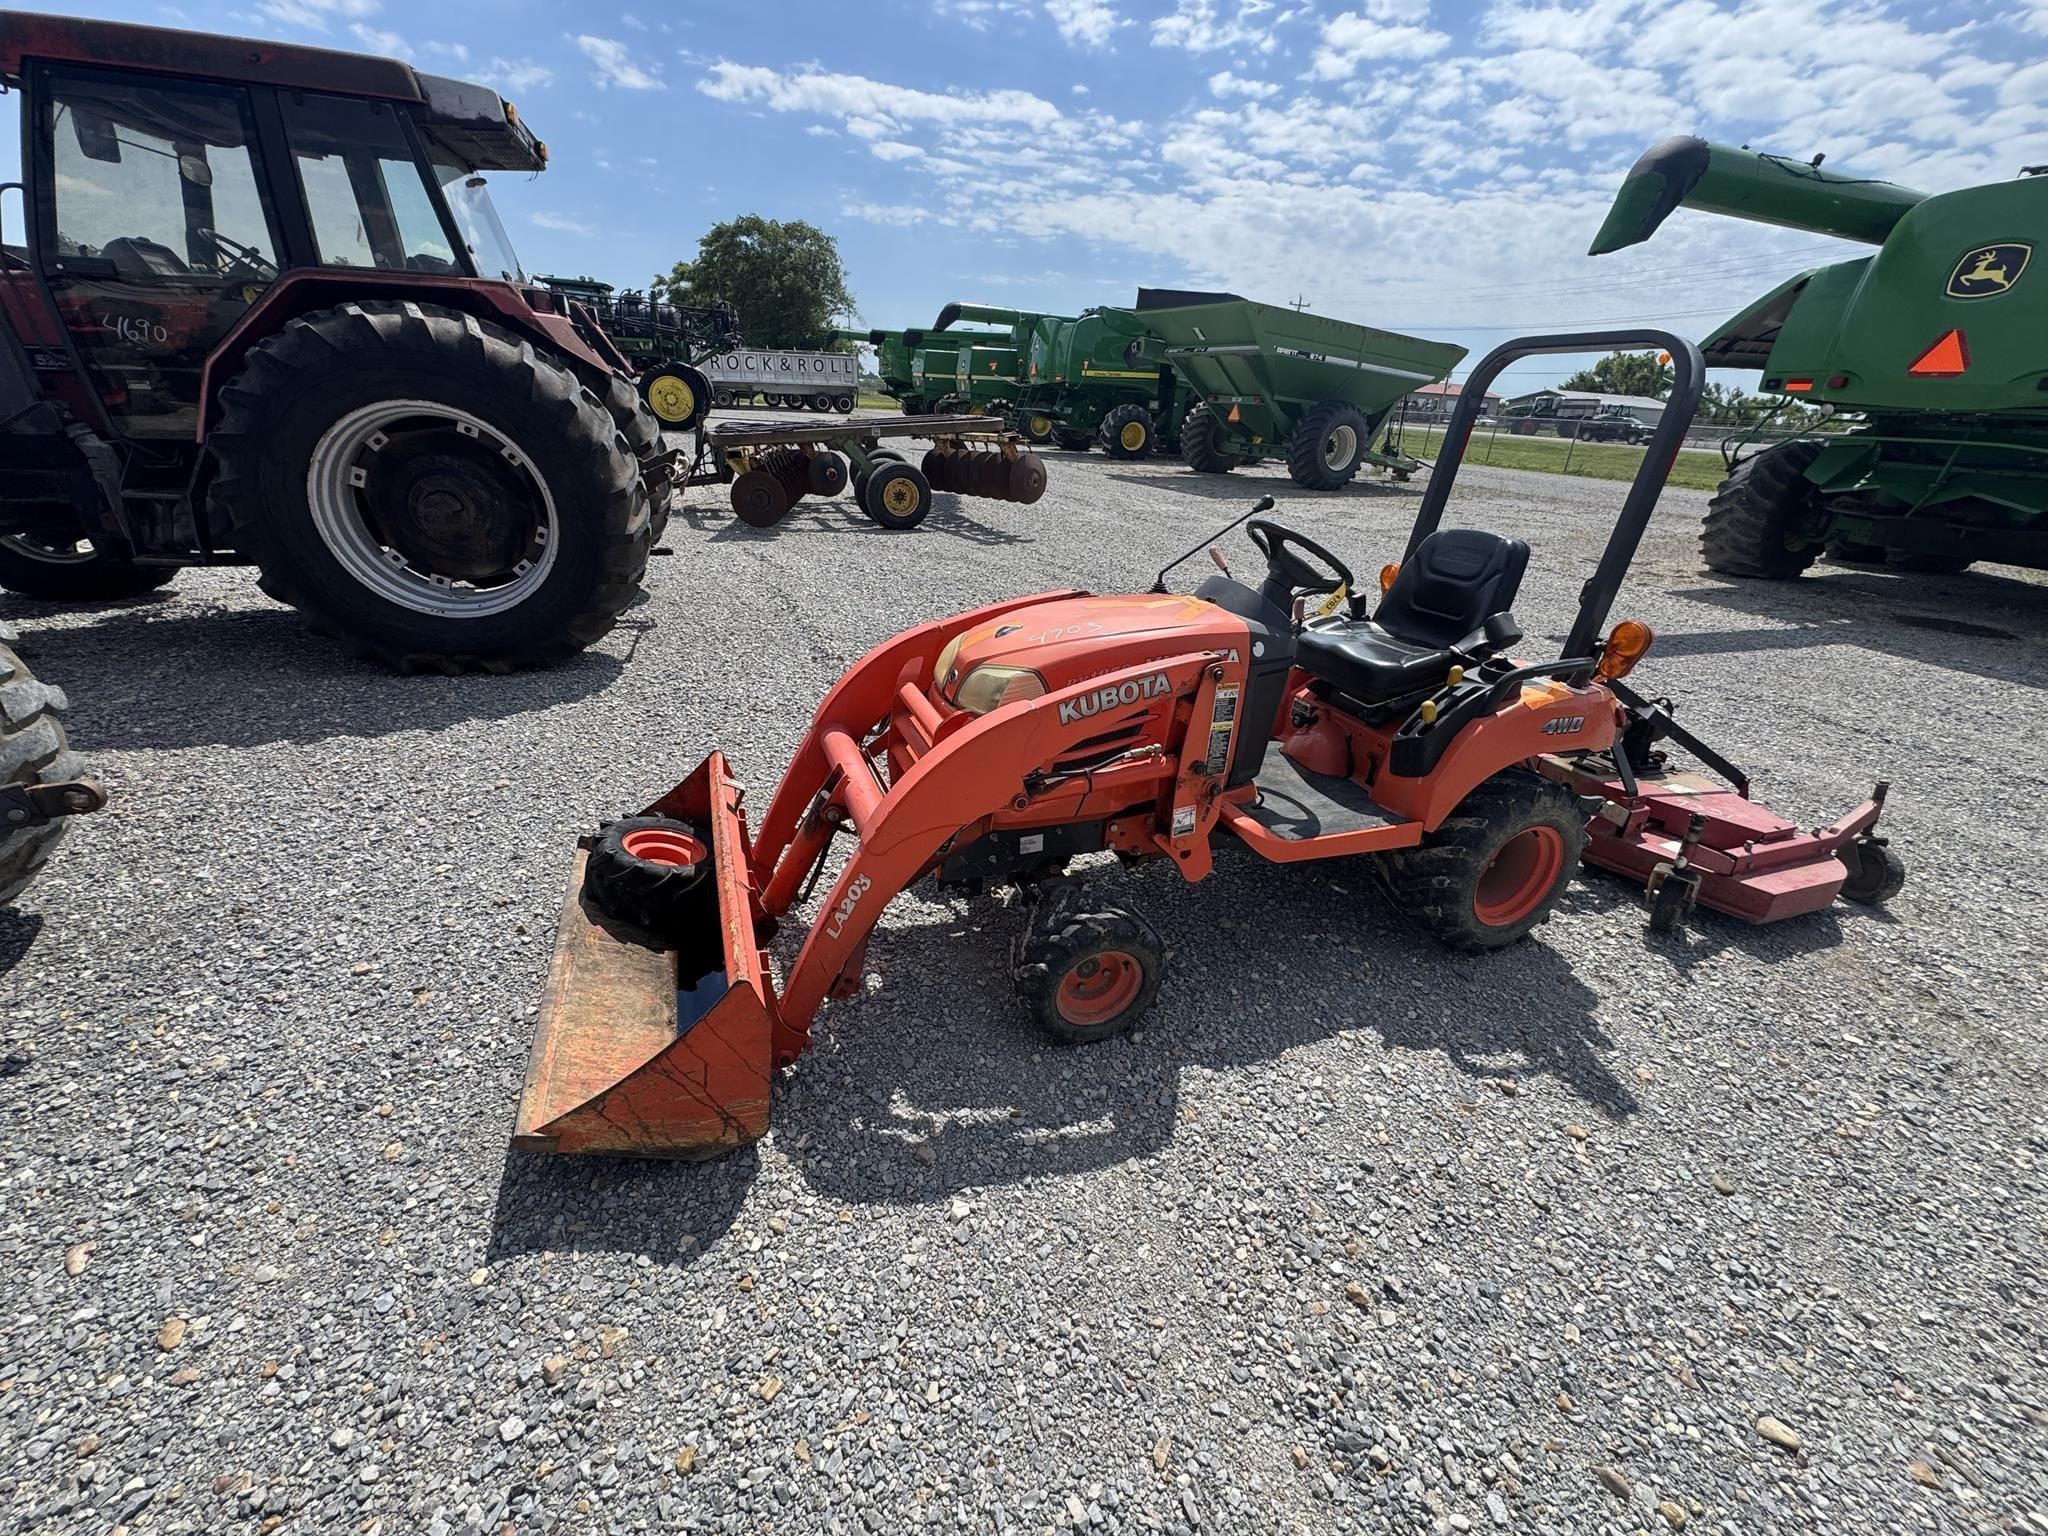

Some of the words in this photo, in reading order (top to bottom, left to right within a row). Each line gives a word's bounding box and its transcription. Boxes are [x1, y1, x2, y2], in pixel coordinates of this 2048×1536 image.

[102, 313, 167, 342] 4690
[1028, 622, 1103, 645] 4703
[1058, 672, 1172, 726] KUBOTA
[1540, 716, 1585, 735] 4WD
[826, 873, 872, 939] LA203
